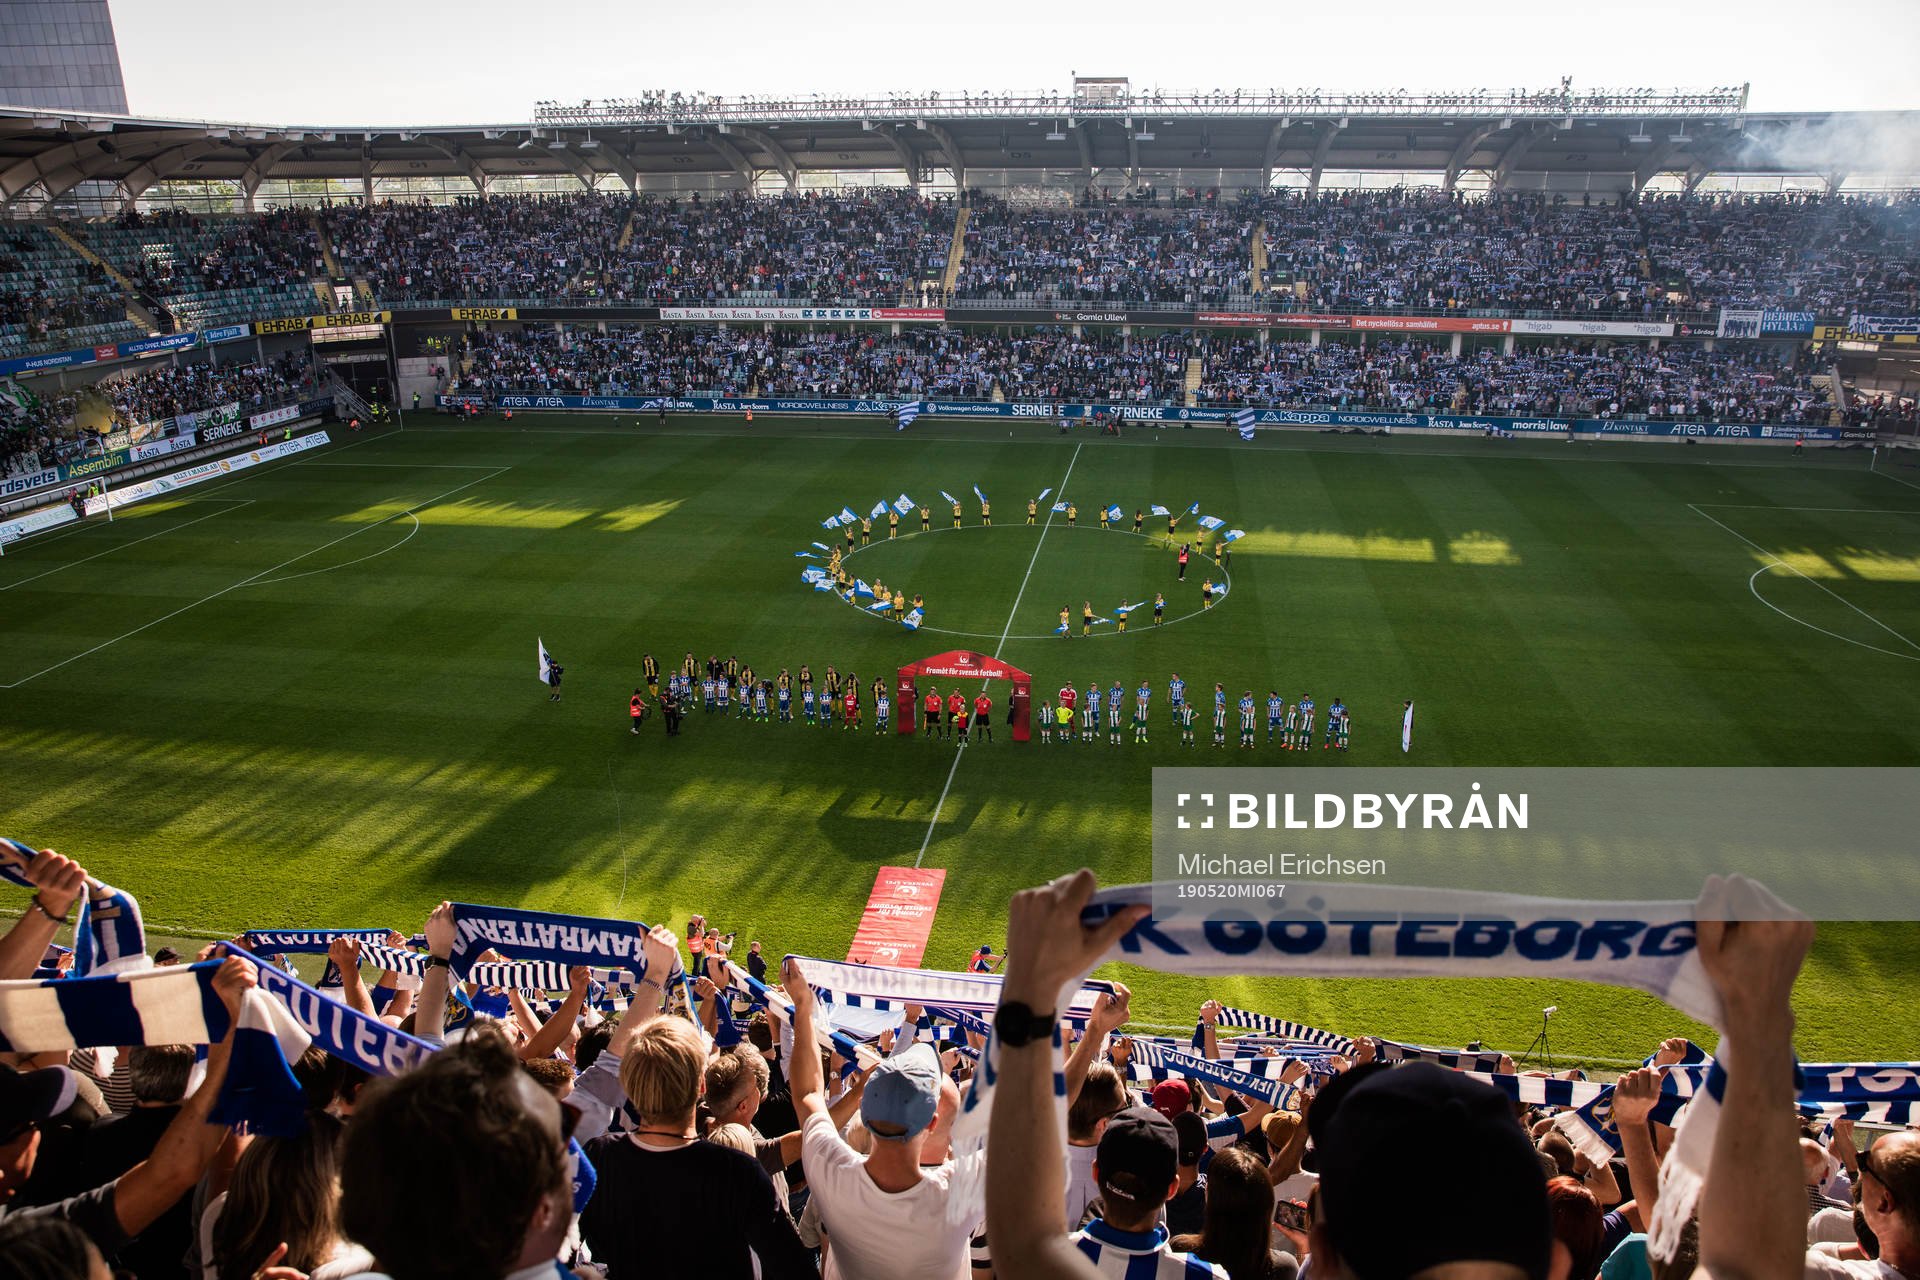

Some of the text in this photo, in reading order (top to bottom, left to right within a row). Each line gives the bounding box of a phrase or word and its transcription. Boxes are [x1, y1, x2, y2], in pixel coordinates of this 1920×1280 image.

[460, 309, 498, 319] EHRAB
[662, 311, 682, 319] RASTA
[686, 311, 705, 319] RASTA
[709, 311, 728, 319] RASTA
[732, 311, 752, 319] RASTA
[756, 311, 775, 319] RASTA
[779, 311, 799, 319] RASTA
[1077, 313, 1103, 321] Gamla
[1104, 313, 1127, 321] Ullevi
[326, 313, 371, 326] EHRAB
[1356, 319, 1367, 327] Det
[262, 319, 304, 333] EHRAB
[1528, 322, 1552, 332] higab
[1582, 323, 1607, 333] higab
[1638, 324, 1662, 334] higab
[502, 397, 531, 407] ATEA
[536, 397, 565, 407] ATEA
[713, 401, 736, 410] RASTA
[938, 404, 1000, 413] Volkswagen Göteborg
[1012, 404, 1065, 416] SERNEE
[1191, 411, 1226, 419] Volkswagen
[1280, 411, 1330, 423] Kappa
[1428, 420, 1454, 428] RASTA
[203, 421, 243, 442] SERNEKE
[1670, 424, 1707, 436] ATEA
[1713, 425, 1751, 437] ATEA
[170, 440, 191, 451] RASTA
[306, 434, 329, 448] ATEA
[279, 441, 303, 455] ATEA
[138, 448, 160, 460] RASTA
[69, 455, 124, 477] Assemblin
[949, 667, 959, 676] för
[959, 668, 979, 677] svensk
[1202, 896, 1698, 962] GÖTEBORG
[962, 1013, 981, 1030] IFK
